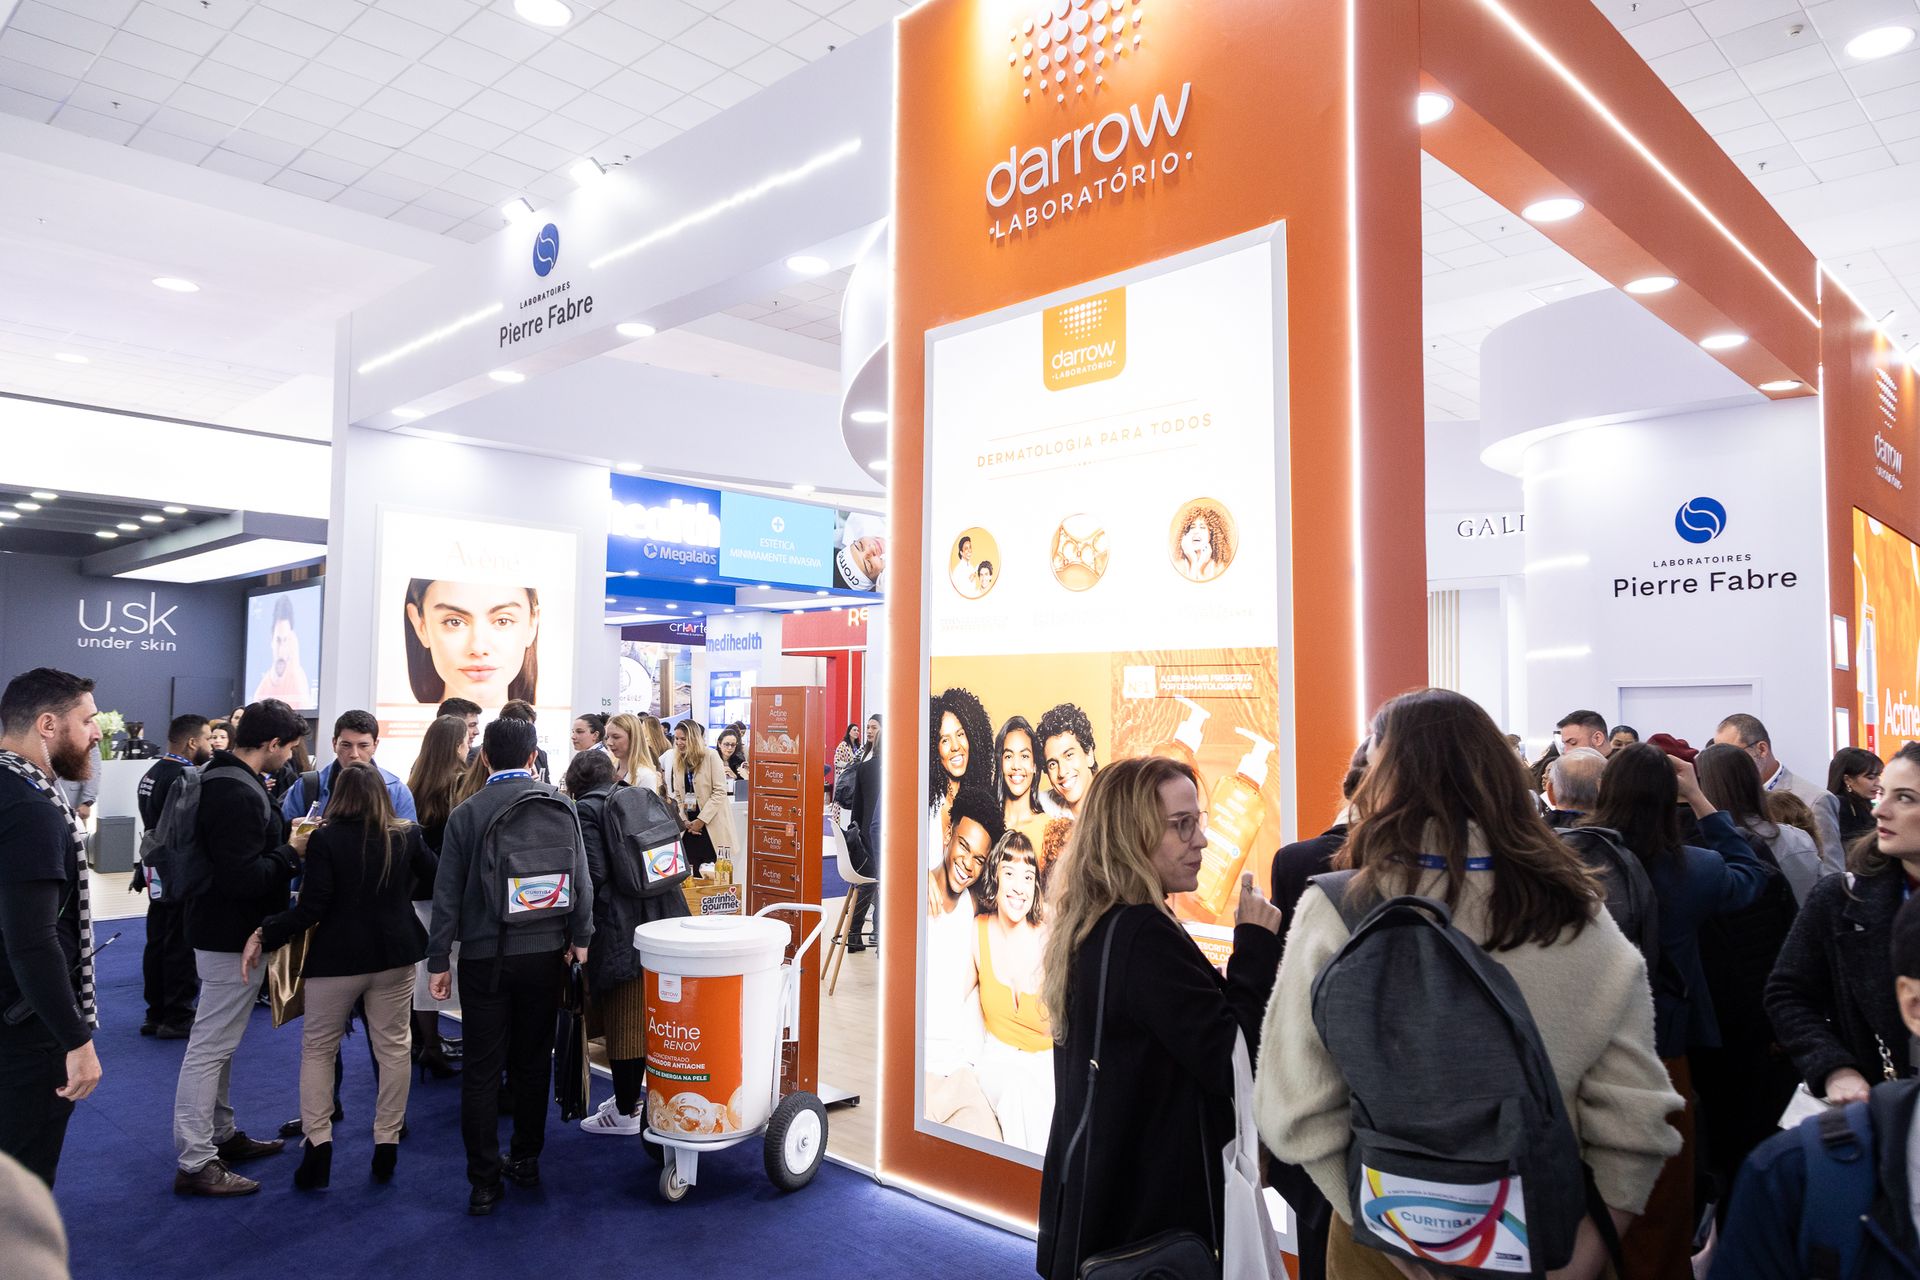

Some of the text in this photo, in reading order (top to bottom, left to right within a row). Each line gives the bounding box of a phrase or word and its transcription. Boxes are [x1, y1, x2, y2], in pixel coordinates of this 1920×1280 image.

[985, 82, 1191, 207] darrow
[994, 152, 1180, 238] LABORATÓRIO
[519, 281, 571, 310] LABORATOIRES
[500, 295, 593, 348] Pierre Fabre
[1051, 340, 1117, 370] darrow
[976, 413, 1212, 468] DERMATOLOGIA PARA TODOS
[1874, 430, 1903, 475] darrow
[659, 546, 717, 565] Megalabs
[1653, 553, 1752, 568] LABORATOIRES
[1613, 568, 1798, 598] Pierre Fabre
[77, 636, 177, 652] under skin
[705, 631, 762, 653] medihealth
[768, 708, 788, 718] Actine
[1884, 687, 1920, 737] Actine
[765, 769, 784, 779] Actine
[763, 802, 783, 813] Actine
[763, 835, 782, 845] Actine
[762, 868, 781, 879] Actine
[702, 893, 737, 905] carrinho
[702, 900, 739, 914] gourmet
[648, 1015, 701, 1040] Actine
[663, 1040, 701, 1052] RENOV
[661, 1071, 683, 1081] ENERGIA
